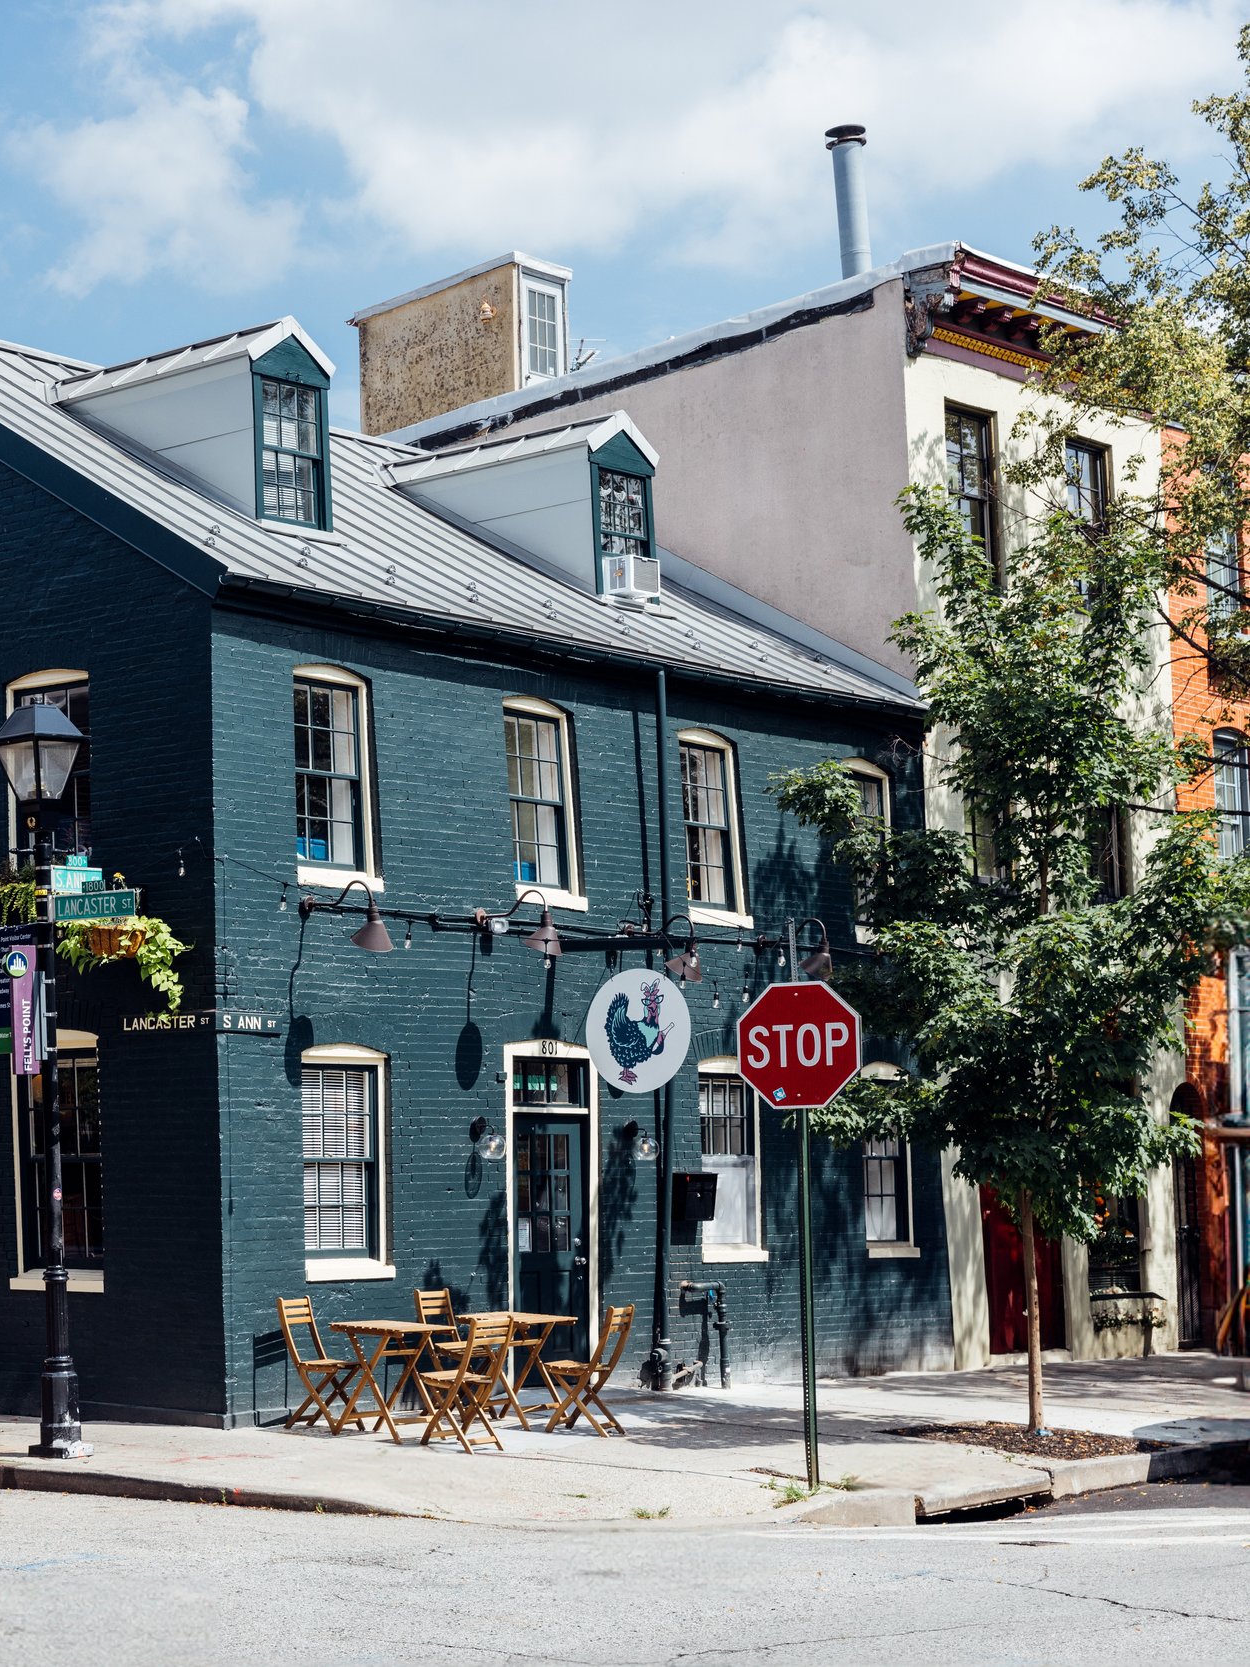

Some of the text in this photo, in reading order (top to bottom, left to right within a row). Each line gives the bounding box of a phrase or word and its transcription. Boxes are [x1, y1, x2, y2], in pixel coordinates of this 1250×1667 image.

[57, 896, 117, 917] LANCASTER
[123, 1015, 210, 1031] LANCASTER ST
[223, 1015, 277, 1030] S ANN ST
[22, 999, 33, 1071] FELL'S POINT
[541, 1040, 558, 1055] 801
[747, 1022, 849, 1069] STOP
